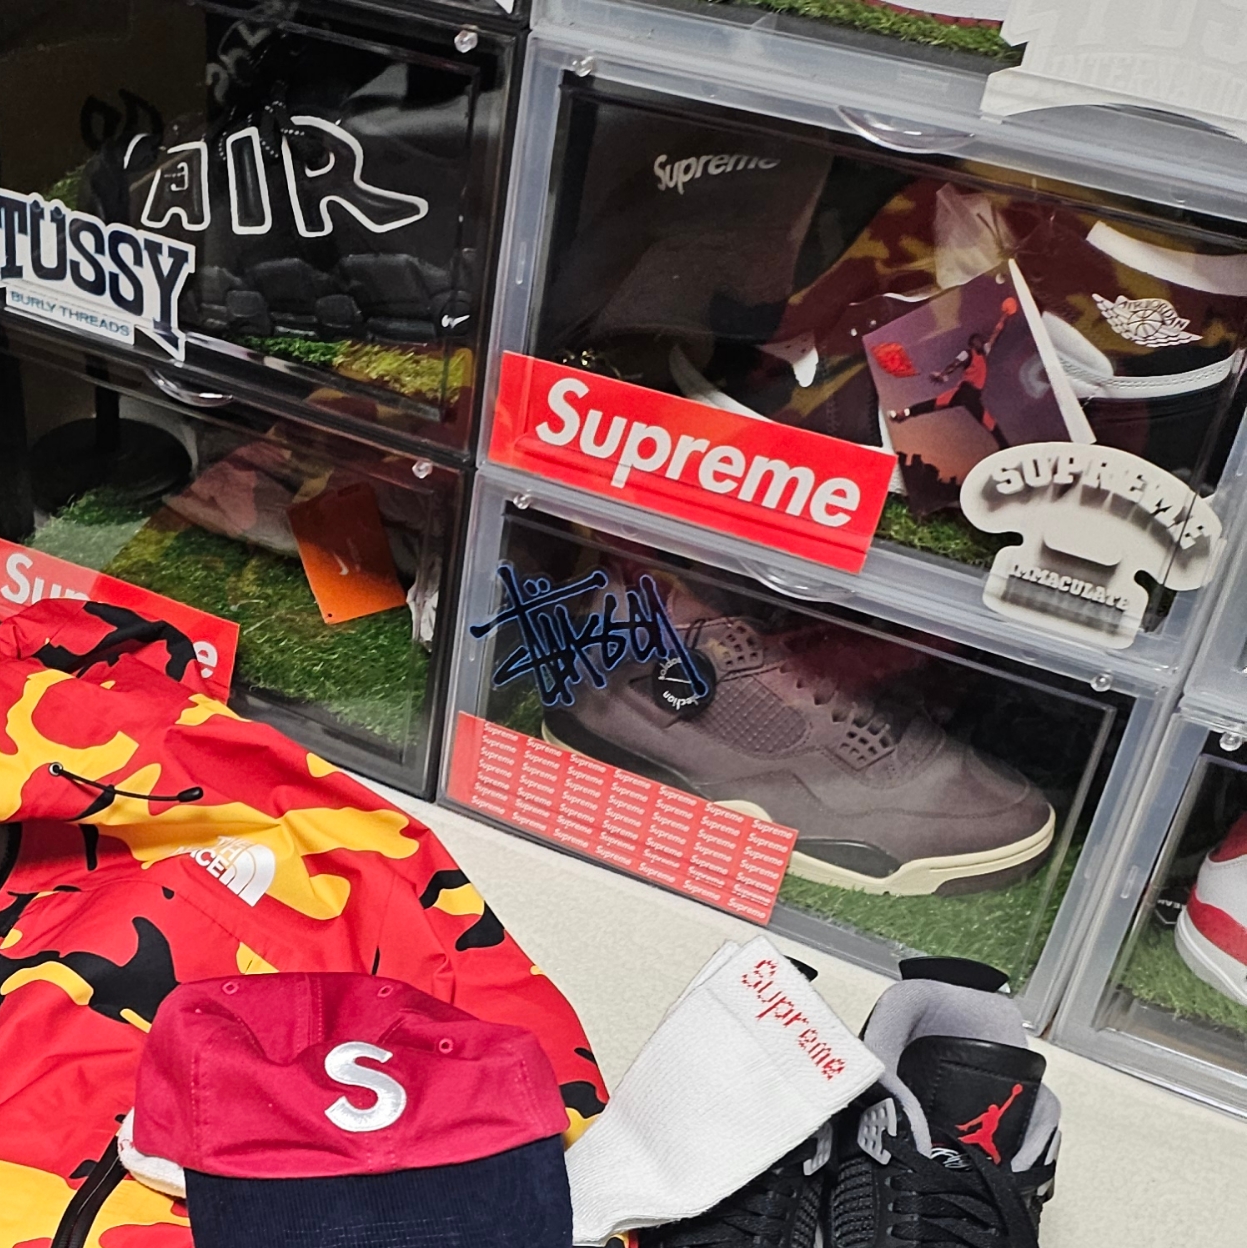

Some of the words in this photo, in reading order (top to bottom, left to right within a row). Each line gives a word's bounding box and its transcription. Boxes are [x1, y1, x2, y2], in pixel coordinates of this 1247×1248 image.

[141, 115, 429, 238] AIR
[10, 290, 56, 313] BURLY
[60, 305, 131, 337] THREADS
[535, 377, 861, 528] Supreme
[993, 456, 1208, 550] SUPREME
[1011, 563, 1131, 612] IMMACULATE
[477, 772, 510, 790] Supreme
[517, 788, 552, 807] Supreme
[559, 804, 595, 823] Supreme
[602, 820, 638, 840] Supreme
[645, 838, 683, 857] Supreme
[690, 855, 728, 875] Supreme
[736, 872, 775, 893] Supreme
[479, 759, 512, 778] Supreme
[520, 775, 555, 794] Supreme
[562, 791, 598, 810] Supreme
[605, 808, 641, 827] Supreme
[649, 824, 686, 845] Supreme
[694, 842, 732, 862] Supreme
[740, 859, 779, 879] Supreme
[480, 747, 514, 765] Supreme
[522, 763, 557, 782] Supreme
[564, 779, 601, 798] Supreme
[608, 795, 645, 815] Supreme
[652, 812, 690, 832] Supreme
[697, 829, 736, 849] Supreme
[744, 846, 784, 866] Supreme
[482, 735, 517, 753] Supreme
[524, 751, 560, 769] Supreme
[567, 766, 604, 785] Supreme
[611, 782, 648, 802] Supreme
[655, 799, 693, 819] Supreme
[701, 816, 740, 836] Supreme
[747, 833, 788, 852] Supreme
[484, 722, 518, 741] Supreme
[527, 738, 562, 757] Supreme
[570, 754, 606, 773] Supreme
[614, 770, 651, 789] Supreme
[659, 785, 697, 806] Supreme
[705, 802, 744, 823] Supreme
[752, 819, 793, 839] Supreme
[472, 796, 505, 814] Supreme
[512, 812, 547, 831] Supreme
[554, 828, 588, 848] Supreme
[597, 845, 632, 865] Supreme
[638, 862, 675, 883] Supreme
[683, 880, 720, 900] Supreme
[727, 898, 766, 918] Supreme
[741, 959, 847, 1081] Supreme
[324, 1041, 406, 1132] S
